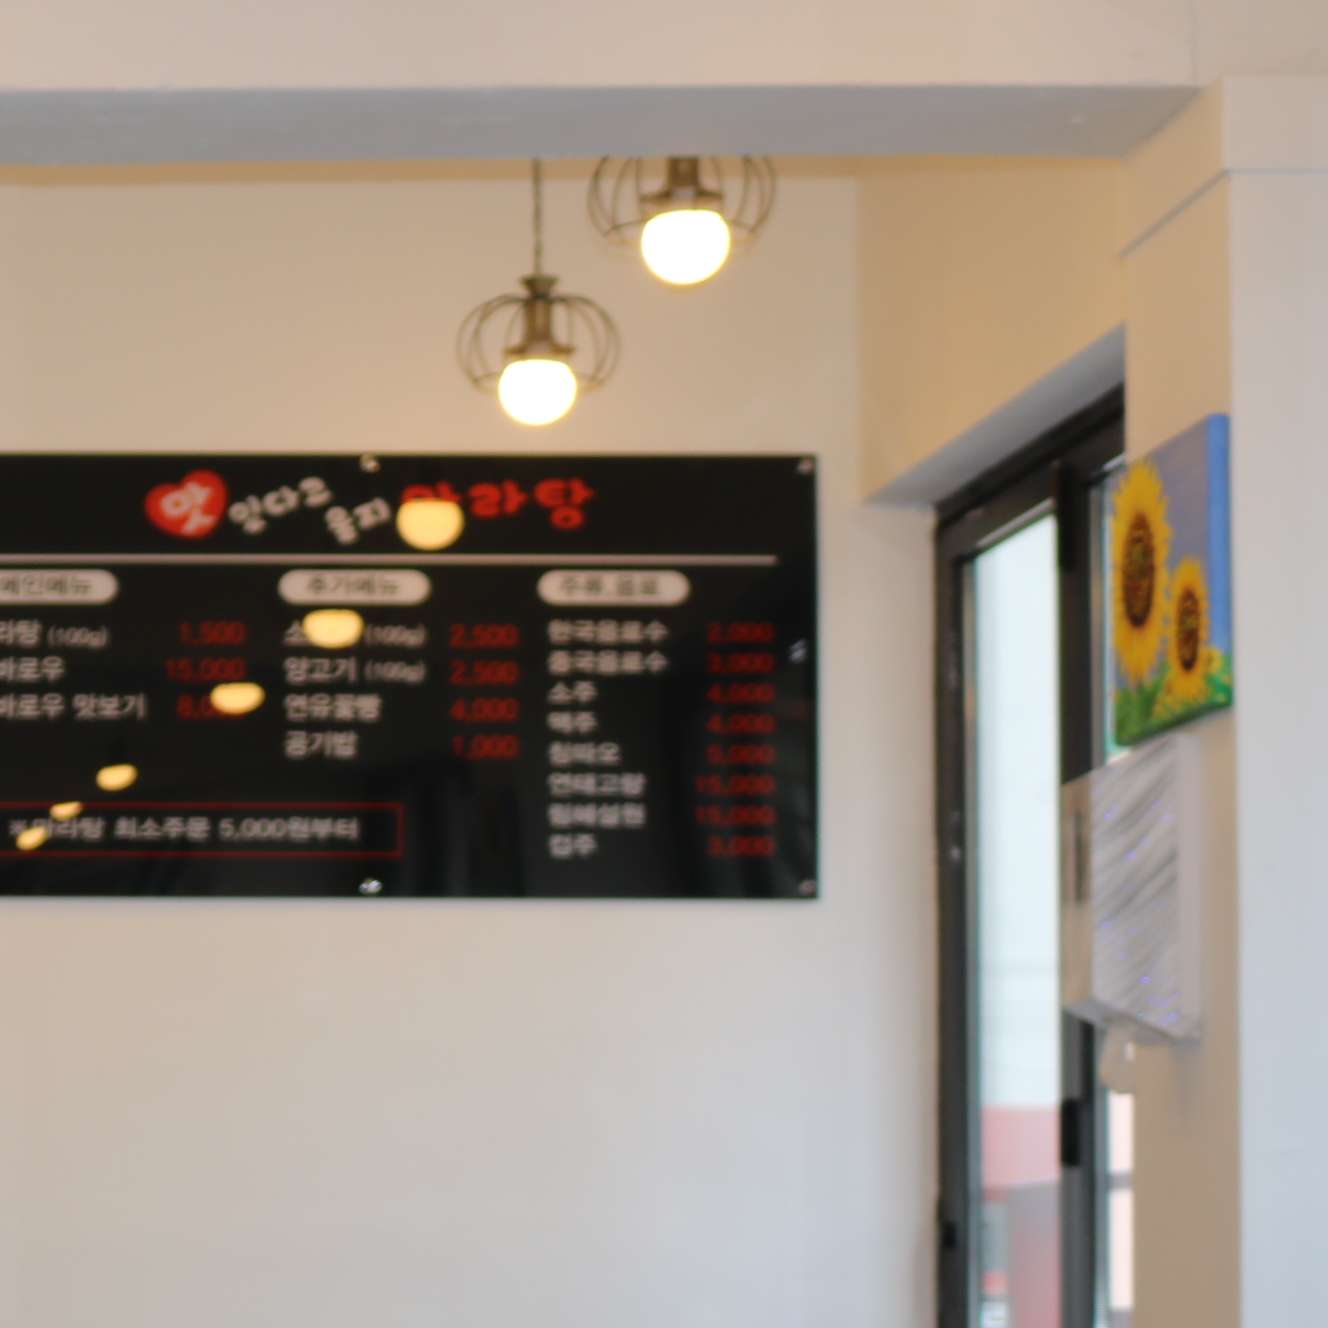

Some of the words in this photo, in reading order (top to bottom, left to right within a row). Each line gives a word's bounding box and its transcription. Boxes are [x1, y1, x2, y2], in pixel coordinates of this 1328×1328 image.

[401, 479, 594, 530] 라탕
[308, 576, 398, 596] 추가메뉴
[47, 626, 109, 649] (100g)
[178, 620, 247, 647] 1,500
[165, 657, 247, 682] 15,000
[283, 657, 357, 684] 양고기
[547, 680, 598, 704] 소주
[72, 692, 148, 720] 맛보기
[449, 697, 520, 722] 4,000
[547, 711, 598, 734] 맥주
[284, 731, 357, 758] 공기밥
[115, 816, 211, 841] 최소주문
[219, 816, 359, 841] 5,000원부터
